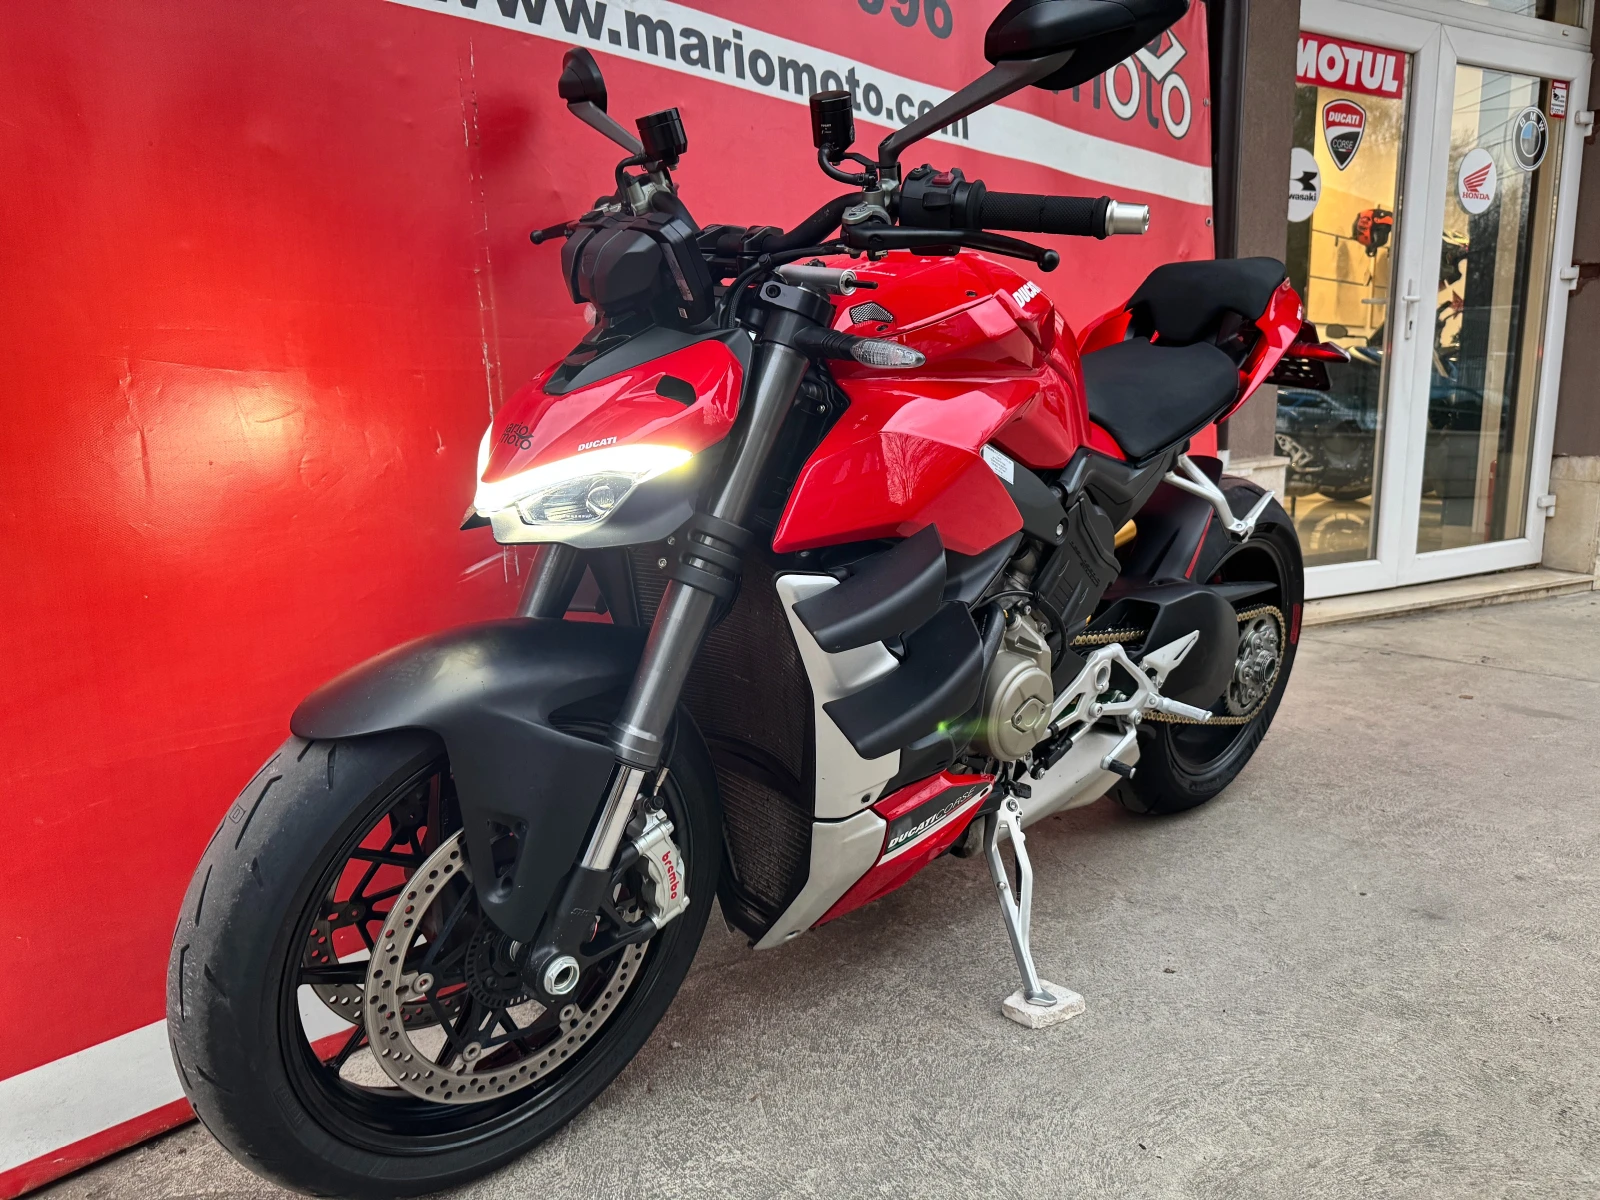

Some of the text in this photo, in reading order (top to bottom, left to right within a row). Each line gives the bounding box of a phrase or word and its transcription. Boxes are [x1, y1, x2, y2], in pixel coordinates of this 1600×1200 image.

[436, 0, 969, 141] ww.mariomoto.c
[1296, 37, 1399, 93] MOTUL
[1052, 54, 1193, 140] oto
[1327, 111, 1361, 125] DUCATI
[1519, 111, 1546, 132] BMW
[1332, 139, 1354, 150] CORSE
[1287, 192, 1317, 202] wasaki
[1462, 191, 1490, 201] HONDA
[504, 421, 529, 436] ario
[499, 433, 532, 451] moto
[577, 436, 618, 452] DUCATI
[661, 850, 680, 900] brembo
